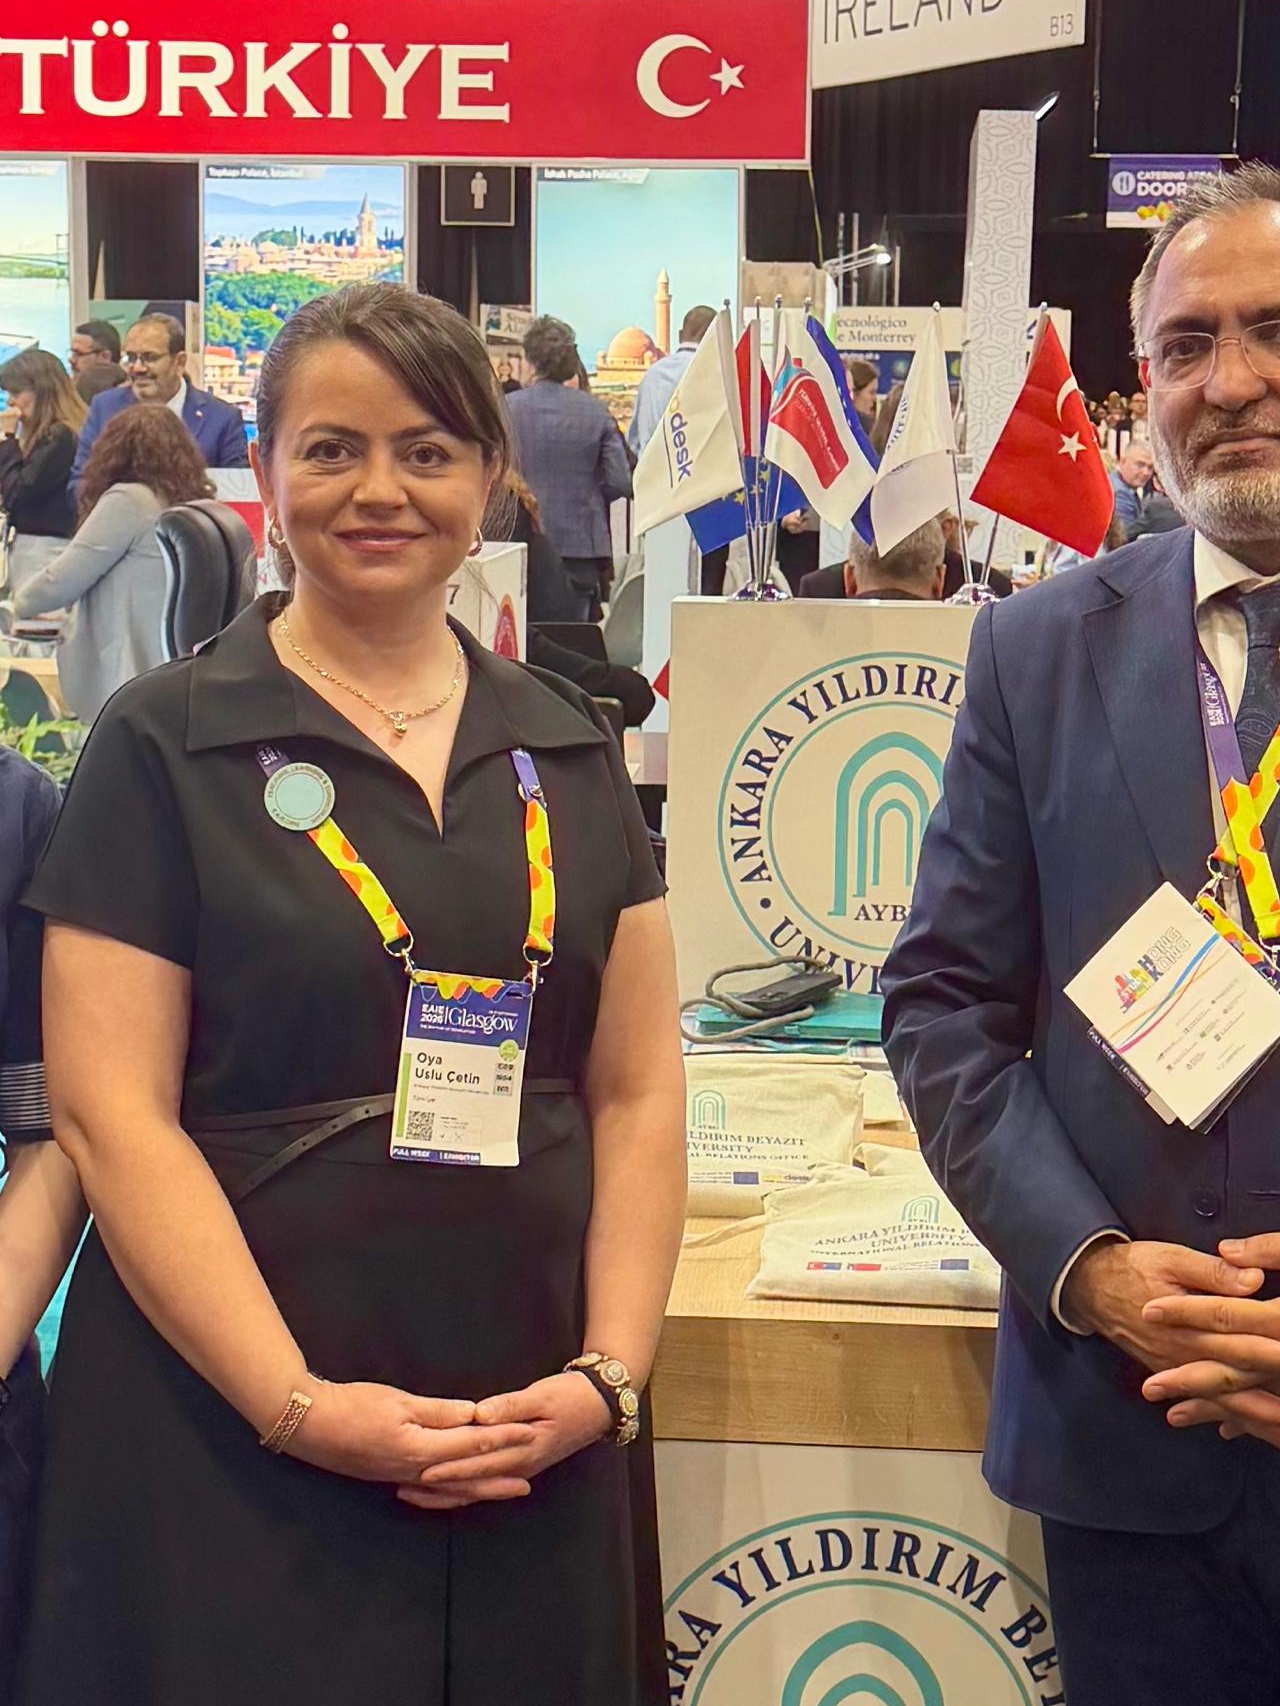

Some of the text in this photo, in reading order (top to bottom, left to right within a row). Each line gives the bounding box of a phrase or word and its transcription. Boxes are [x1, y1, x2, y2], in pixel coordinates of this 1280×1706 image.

[1049, 12, 1075, 37] B13
[837, 315, 907, 330] ecnológico
[848, 330, 916, 346] Monterrey
[730, 662, 962, 884] ANKARA YILDIRI
[853, 904, 912, 922] AYB
[448, 1007, 518, 1035] Glasgow
[417, 1052, 443, 1066] Oya
[415, 1068, 480, 1085] Uslu Çetin
[689, 1131, 742, 1143] LDIRIM
[687, 1142, 753, 1153] IVERSITY
[815, 1230, 878, 1246] ANKARA
[712, 1526, 1007, 1614] YILDIRIM
